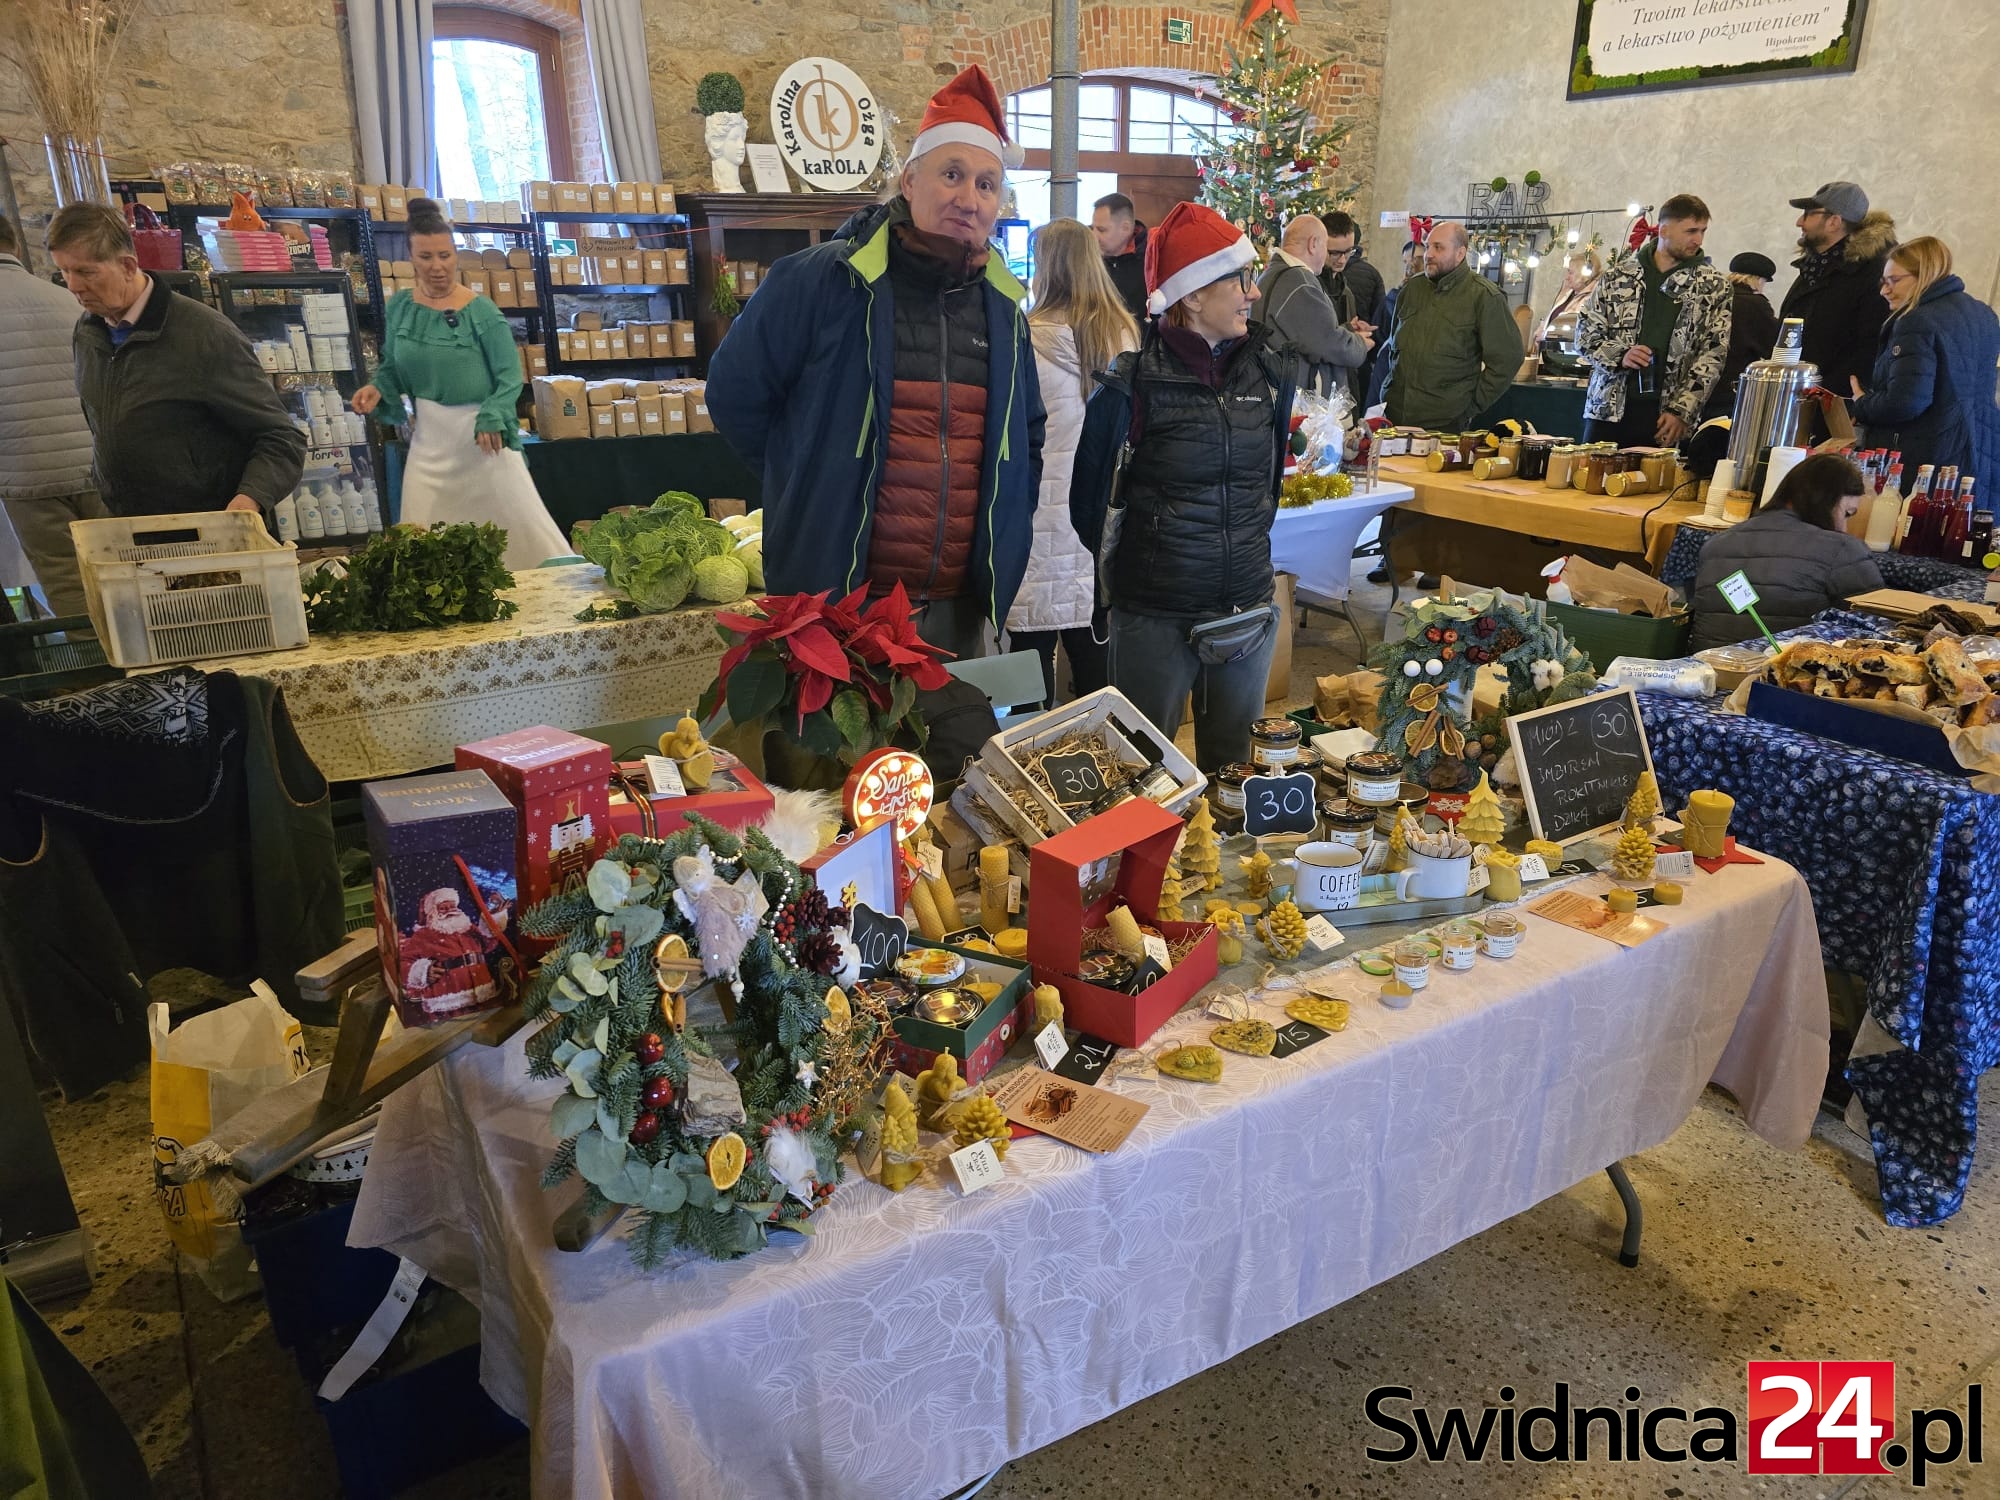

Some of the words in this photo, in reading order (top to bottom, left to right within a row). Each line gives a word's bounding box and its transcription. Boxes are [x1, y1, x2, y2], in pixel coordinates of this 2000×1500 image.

[1632, 8, 1686, 26] Twoim
[1692, 0, 1797, 16] lekarstw
[1603, 41, 1612, 52] a
[1618, 29, 1695, 51] lekarstwo
[1766, 35, 1817, 47] Hipokrates
[777, 79, 802, 156] Karolina
[858, 97, 875, 147] Ożga
[802, 158, 868, 175] kaROLA
[1466, 181, 1551, 226] BAR
[311, 448, 344, 460] Torres
[1628, 671, 1676, 680] DISPOSABLE
[1597, 713, 1627, 738] 30
[377, 779, 489, 798] Christmas
[1061, 767, 1099, 793] 30
[1553, 774, 1637, 806] ROKITNIKIE
[410, 795, 478, 809] Merry
[1259, 787, 1305, 821] 30
[859, 924, 900, 971] 100
[1278, 1023, 1310, 1047] 15
[1074, 1044, 1112, 1069] 21
[970, 1151, 985, 1178] CRAFT
[977, 1149, 989, 1173] WILD
